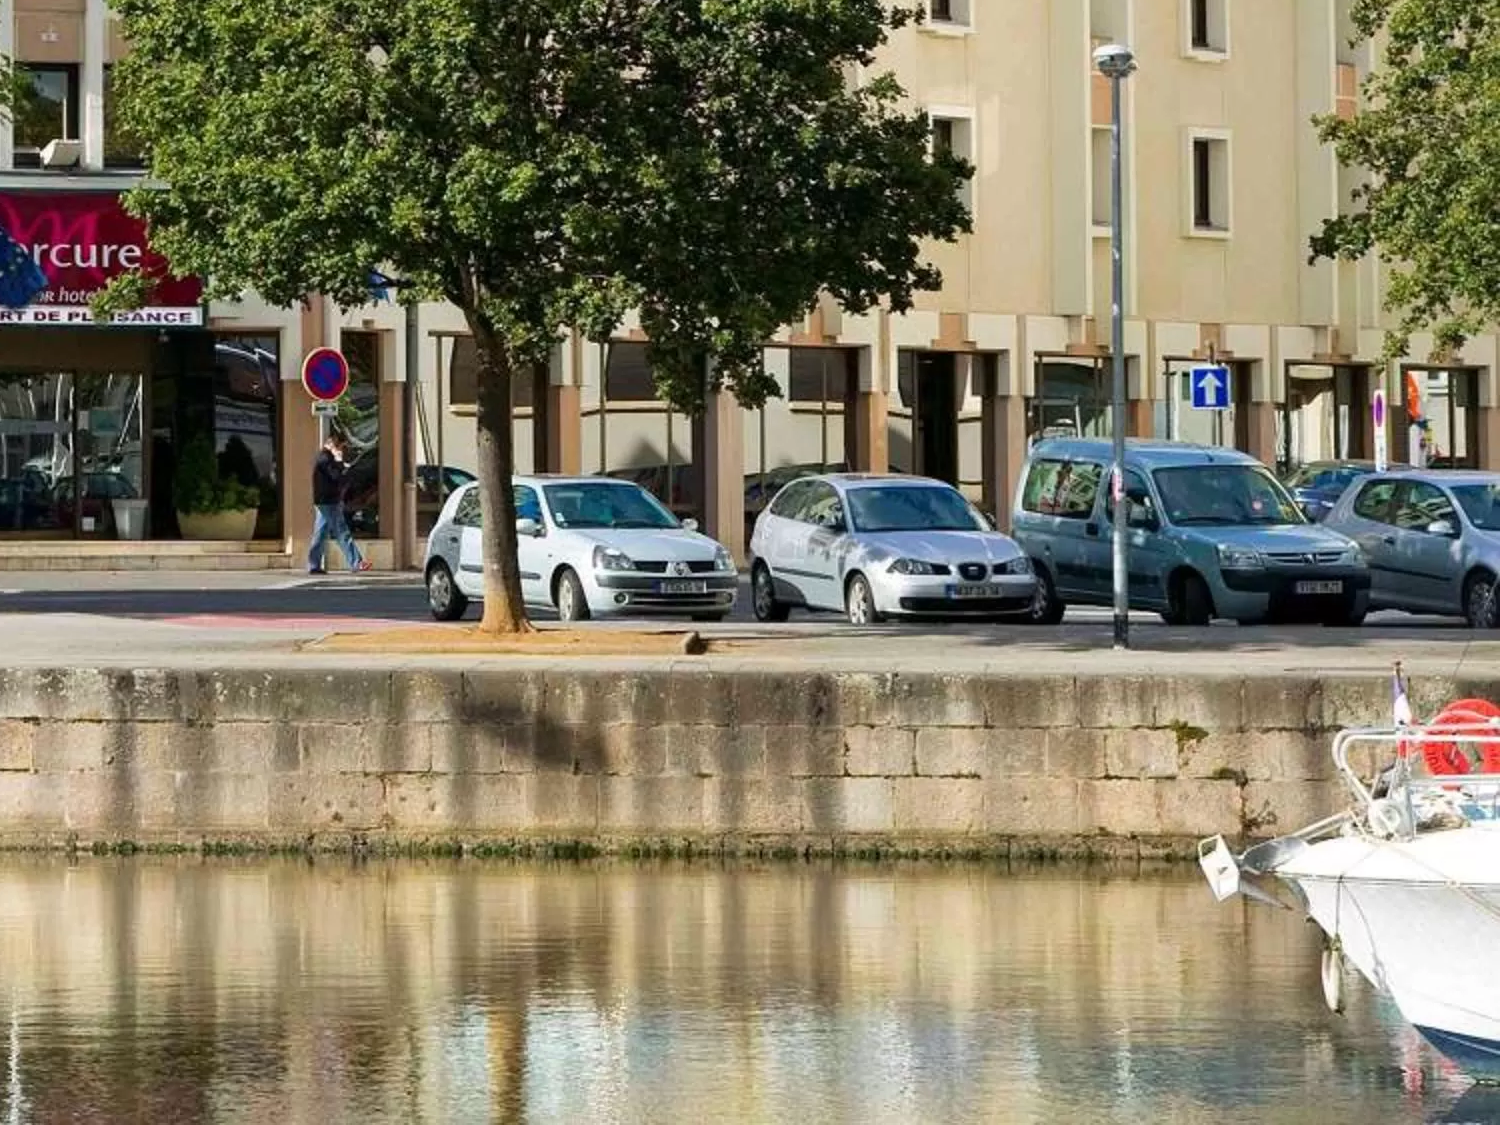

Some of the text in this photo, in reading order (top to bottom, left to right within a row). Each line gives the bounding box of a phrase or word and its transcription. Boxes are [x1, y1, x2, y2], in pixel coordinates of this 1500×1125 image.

[14, 241, 142, 269] rcure
[33, 310, 61, 322] DE
[67, 311, 192, 322] PLISANCE
